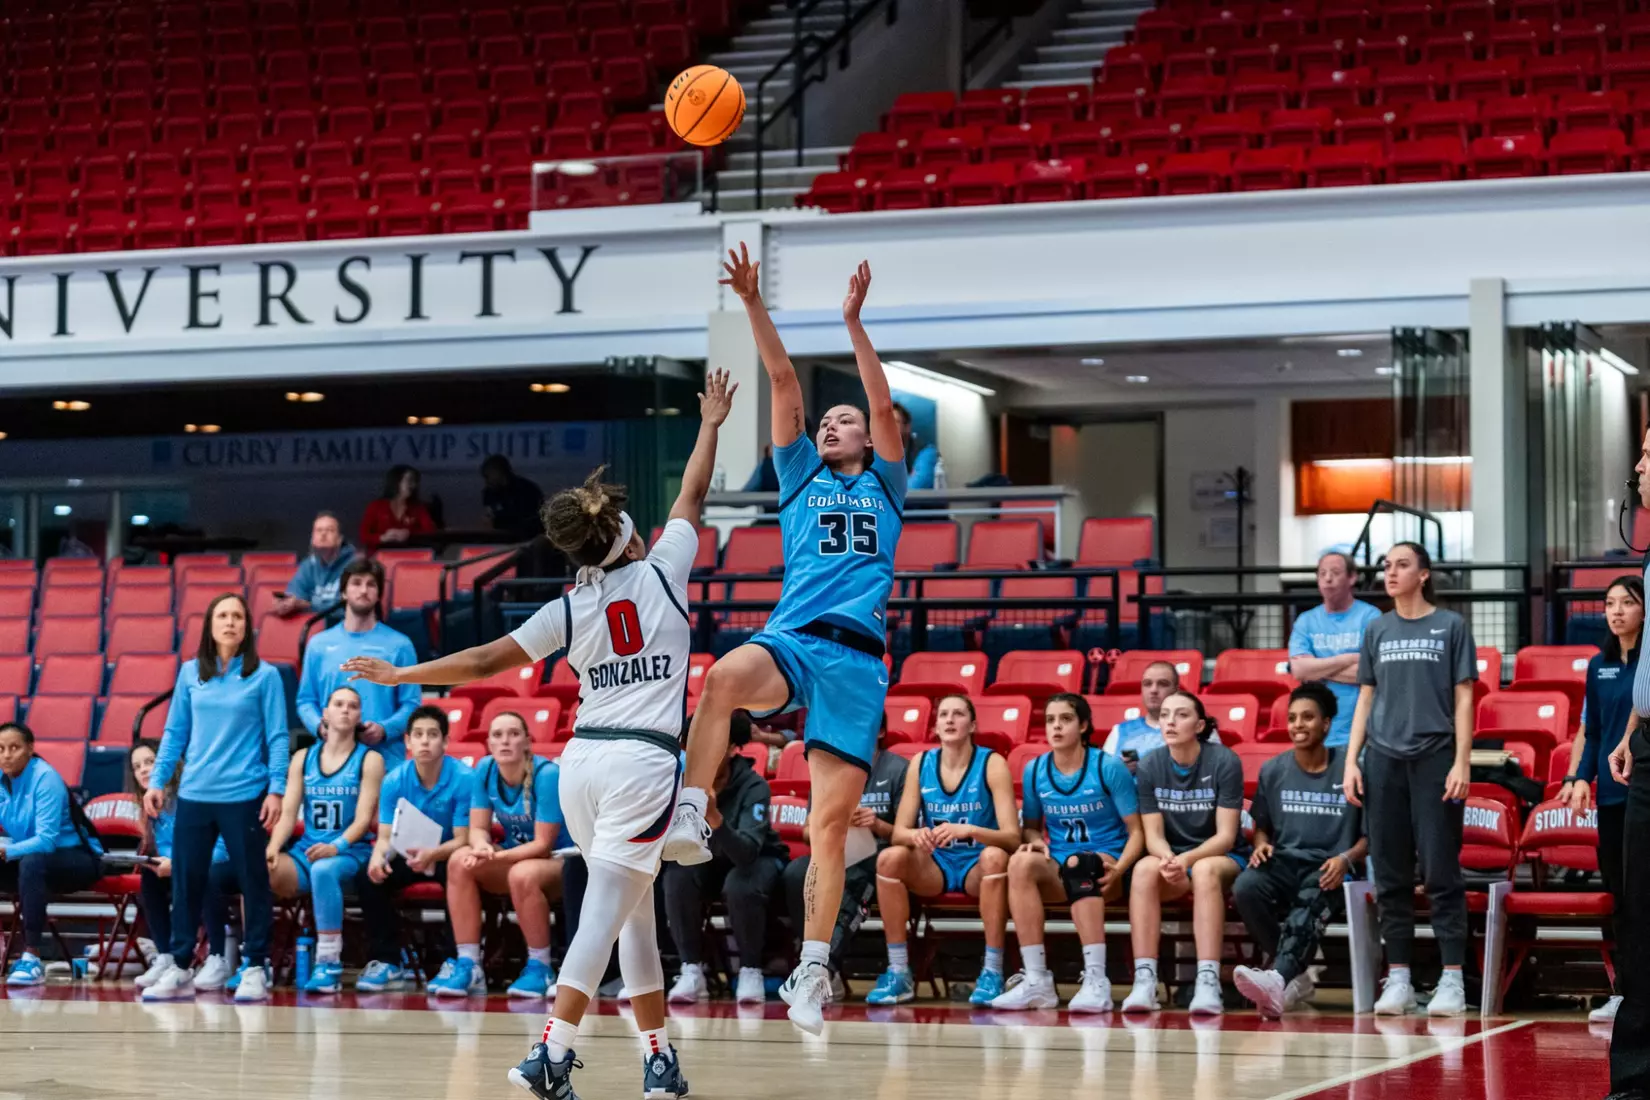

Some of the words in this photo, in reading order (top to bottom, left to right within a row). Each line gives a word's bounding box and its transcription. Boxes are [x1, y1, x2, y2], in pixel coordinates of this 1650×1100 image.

[182, 436, 283, 466] CURRY
[292, 433, 402, 465] FAMILY
[406, 432, 456, 462] VIP
[466, 429, 553, 460] SUITE
[807, 492, 886, 513] COLUMBIA
[818, 511, 879, 557] 35
[604, 598, 645, 657] 0
[1379, 638, 1445, 652] COLUMBIA
[1380, 651, 1440, 663] BASKETBALL
[588, 654, 672, 691] GONZALEZ
[311, 799, 345, 832] 21
[780, 804, 807, 826] BROO
[1157, 801, 1214, 812] BASKETBALL
[1282, 803, 1343, 817] BASKETBALL
[1463, 806, 1501, 831] BROOK
[1534, 807, 1573, 832] STONY
